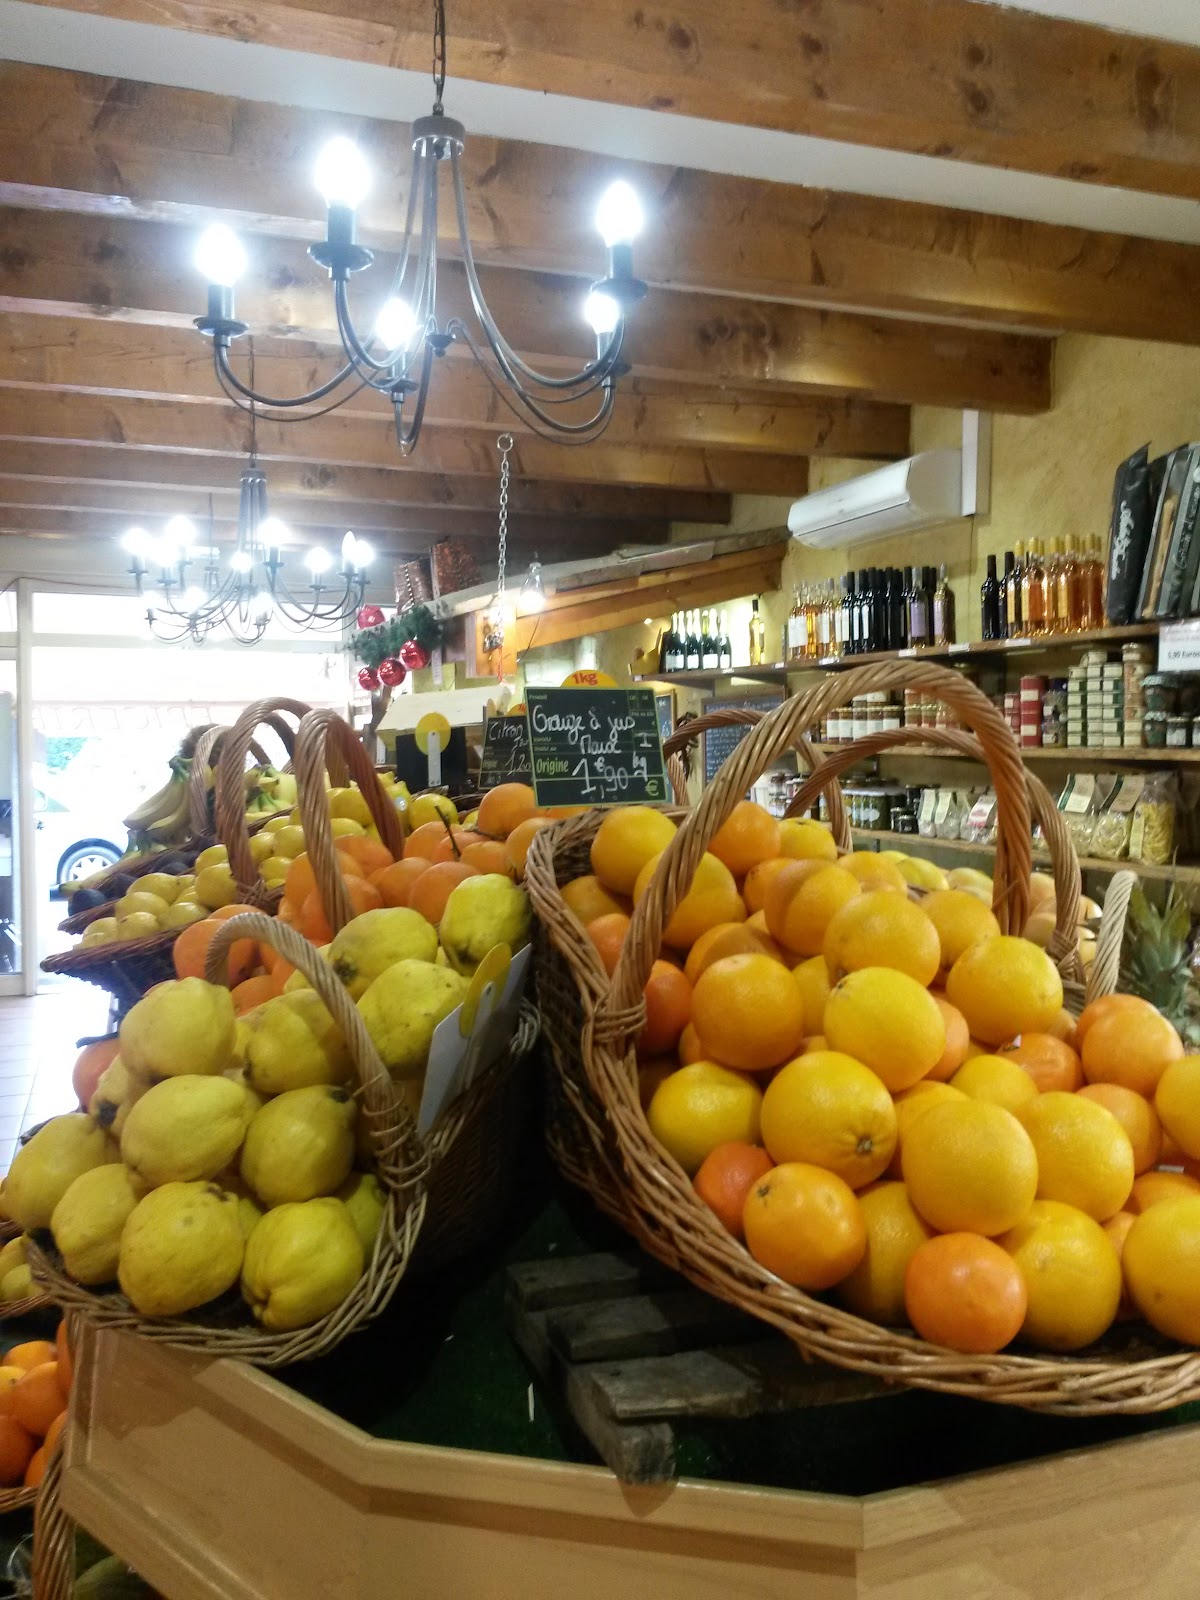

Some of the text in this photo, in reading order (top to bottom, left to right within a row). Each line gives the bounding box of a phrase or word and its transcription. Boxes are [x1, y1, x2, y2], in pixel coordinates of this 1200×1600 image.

[572, 672, 598, 685] 1kg
[489, 720, 523, 741] Citron
[588, 709, 601, 730] à
[608, 716, 636, 742] jus
[536, 756, 569, 775] Origine
[645, 779, 659, 797] €
